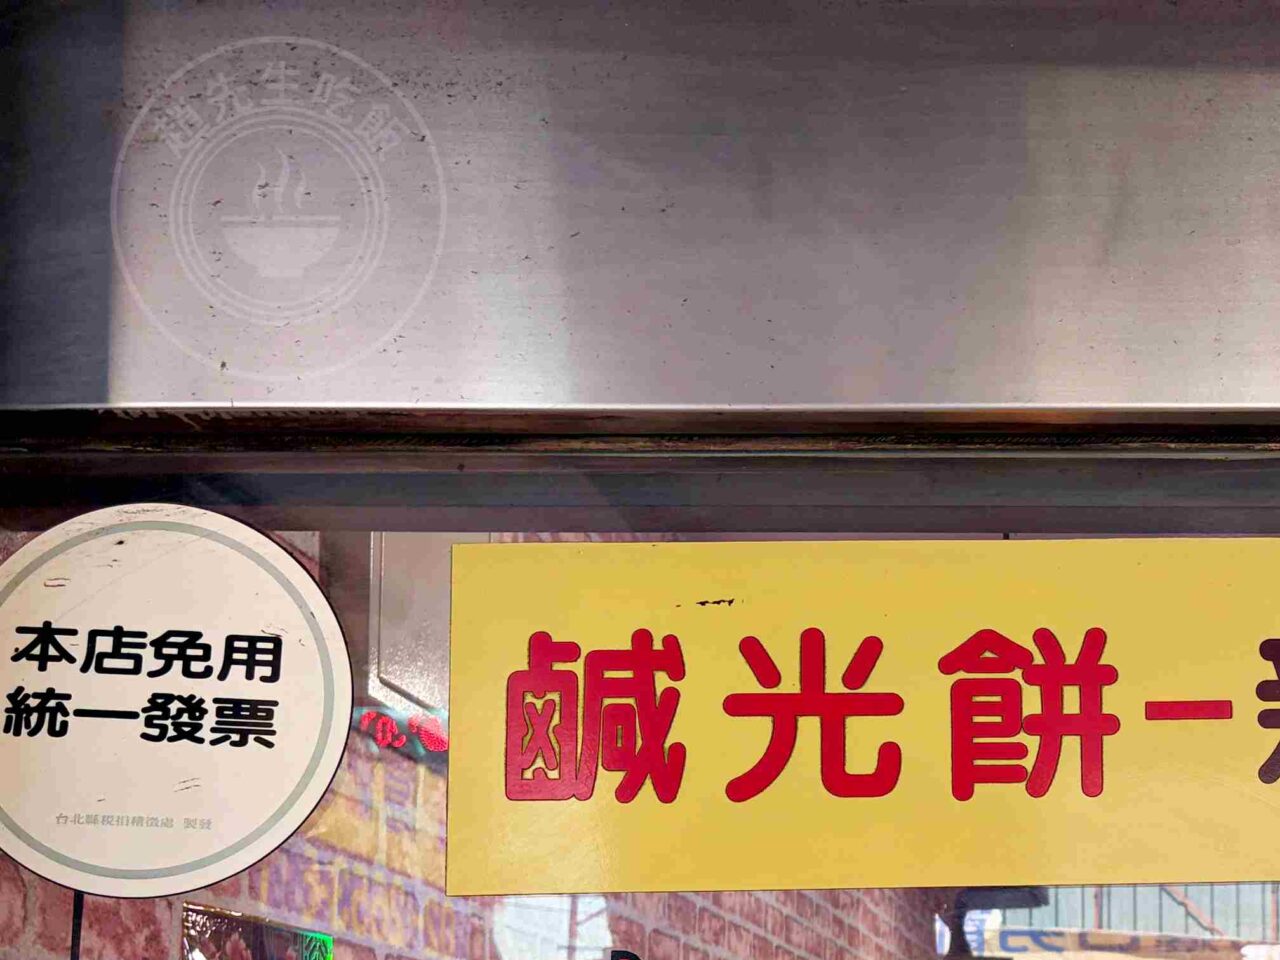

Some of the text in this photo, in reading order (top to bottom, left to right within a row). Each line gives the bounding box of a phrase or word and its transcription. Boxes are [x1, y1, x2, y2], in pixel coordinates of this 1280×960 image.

[10, 620, 283, 683] 本店免用
[2, 686, 279, 749] 統一發票
